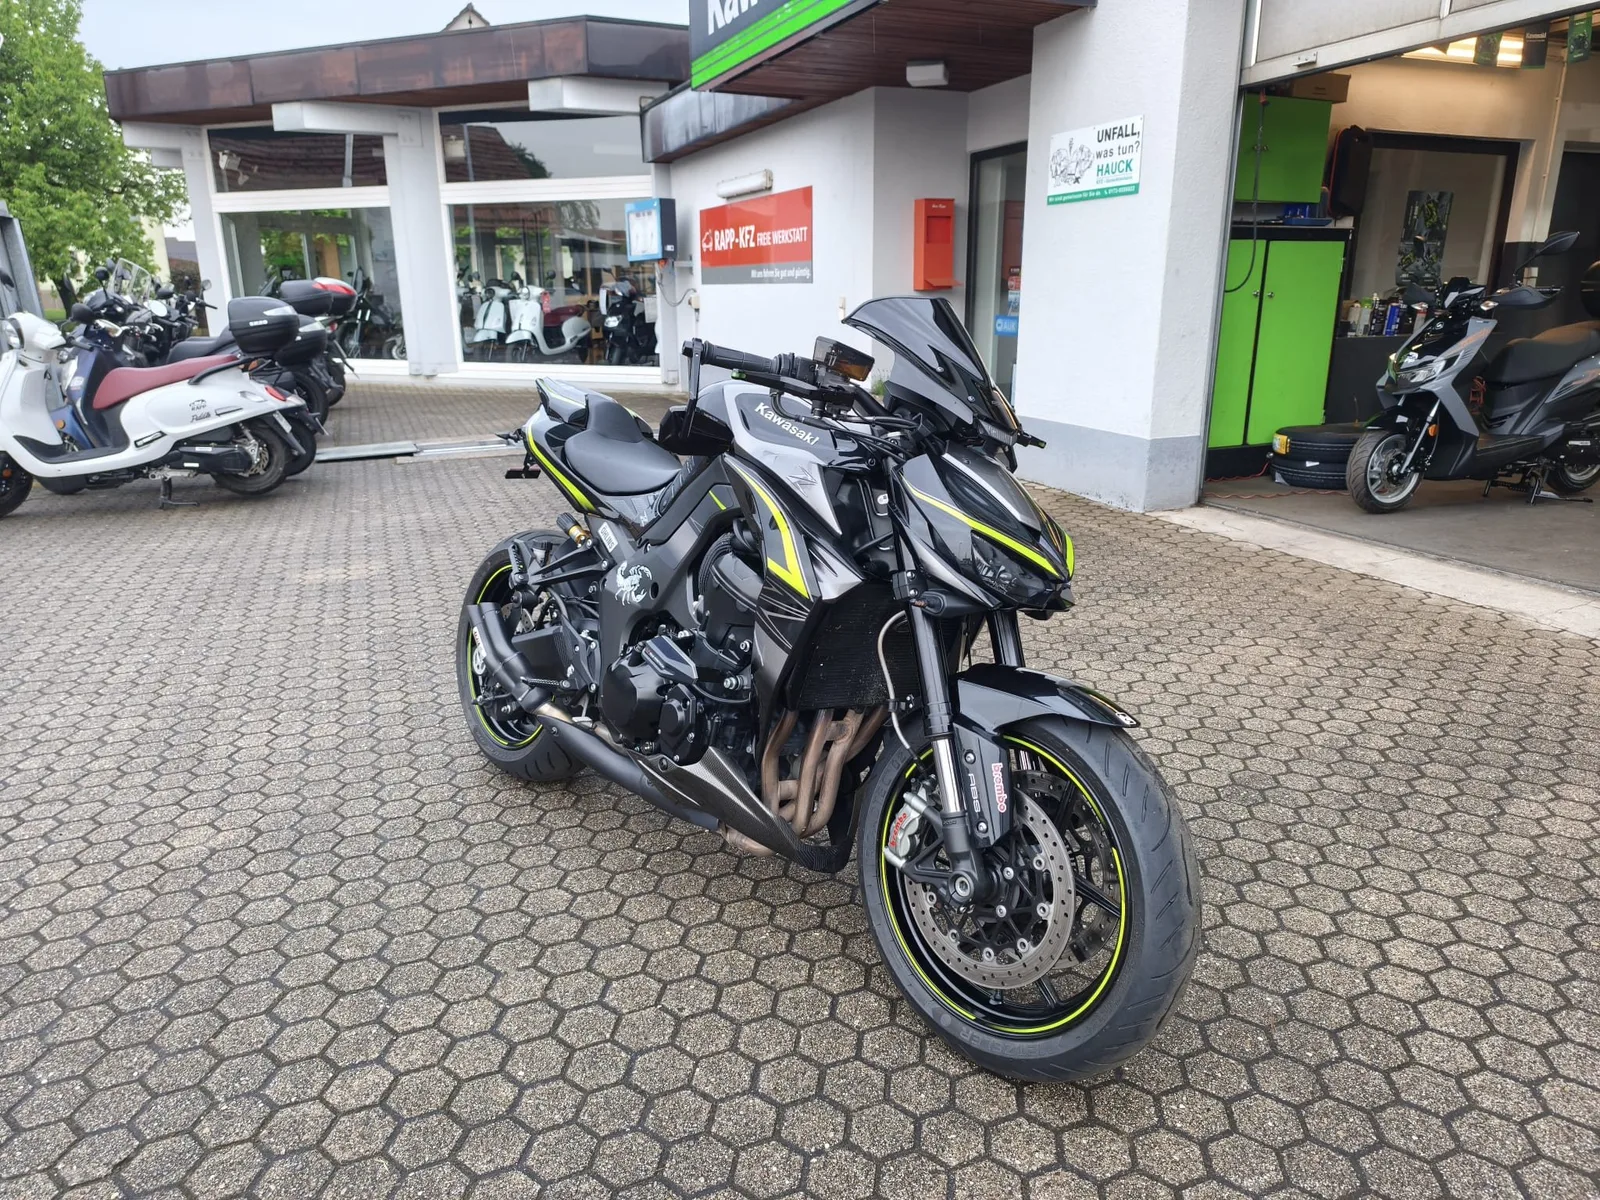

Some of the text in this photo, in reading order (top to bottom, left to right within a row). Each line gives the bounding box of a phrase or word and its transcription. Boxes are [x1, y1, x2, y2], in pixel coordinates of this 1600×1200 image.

[1097, 123, 1140, 143] UNFALL,
[1096, 140, 1141, 160] was tun?
[1097, 158, 1134, 177] HAUCK
[772, 226, 808, 245] WERKSTATT
[754, 402, 820, 446] Kawasaki
[968, 773, 981, 813] ABS
[991, 762, 1008, 813] brembo
[889, 812, 908, 848] brembo
